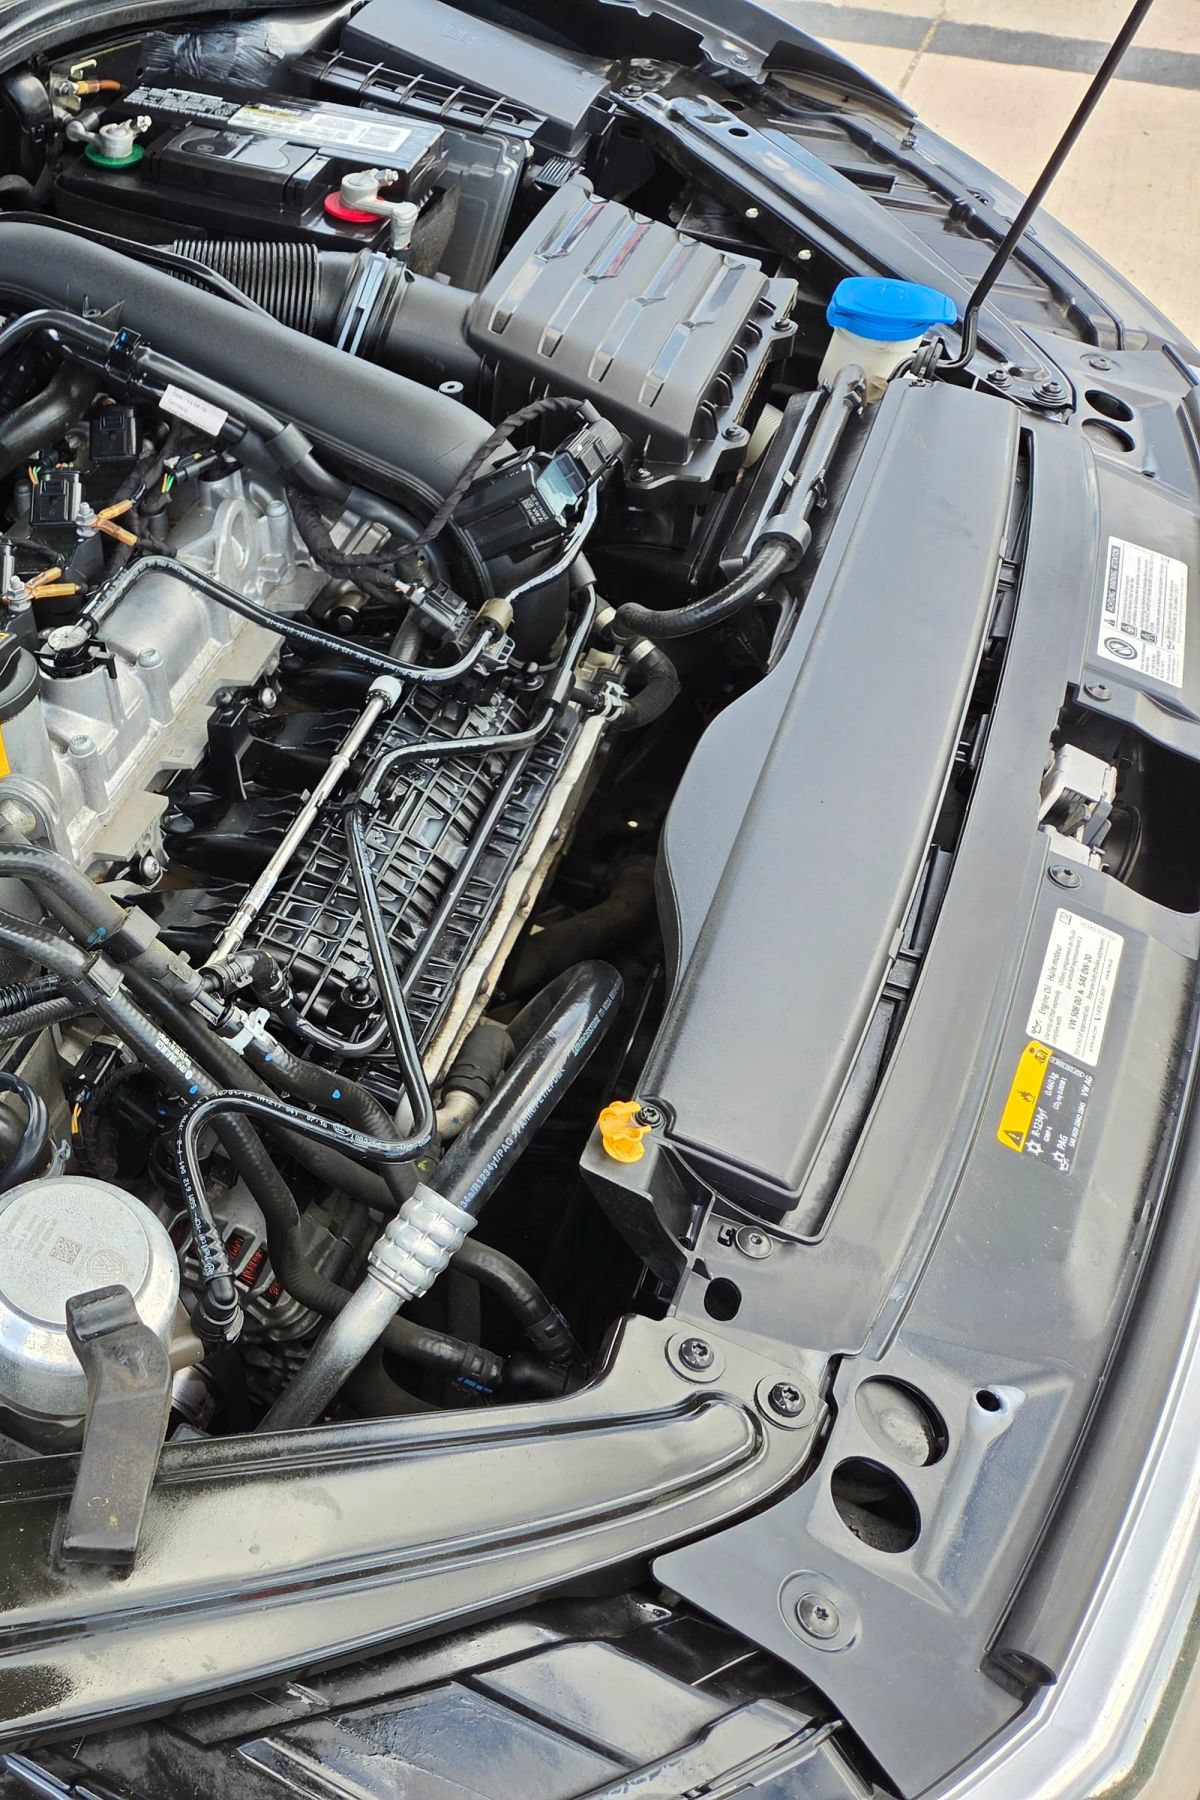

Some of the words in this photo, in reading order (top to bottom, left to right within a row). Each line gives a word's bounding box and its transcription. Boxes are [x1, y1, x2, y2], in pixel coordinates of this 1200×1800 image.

[1037, 992, 1051, 1016] Engine
[1067, 1017, 1077, 1031] VW
[1080, 1083, 1090, 1098] VW
[1030, 1106, 1049, 1139] R-1234yf
[1056, 1132, 1068, 1150] PAG
[183, 1177, 191, 1191] 612
